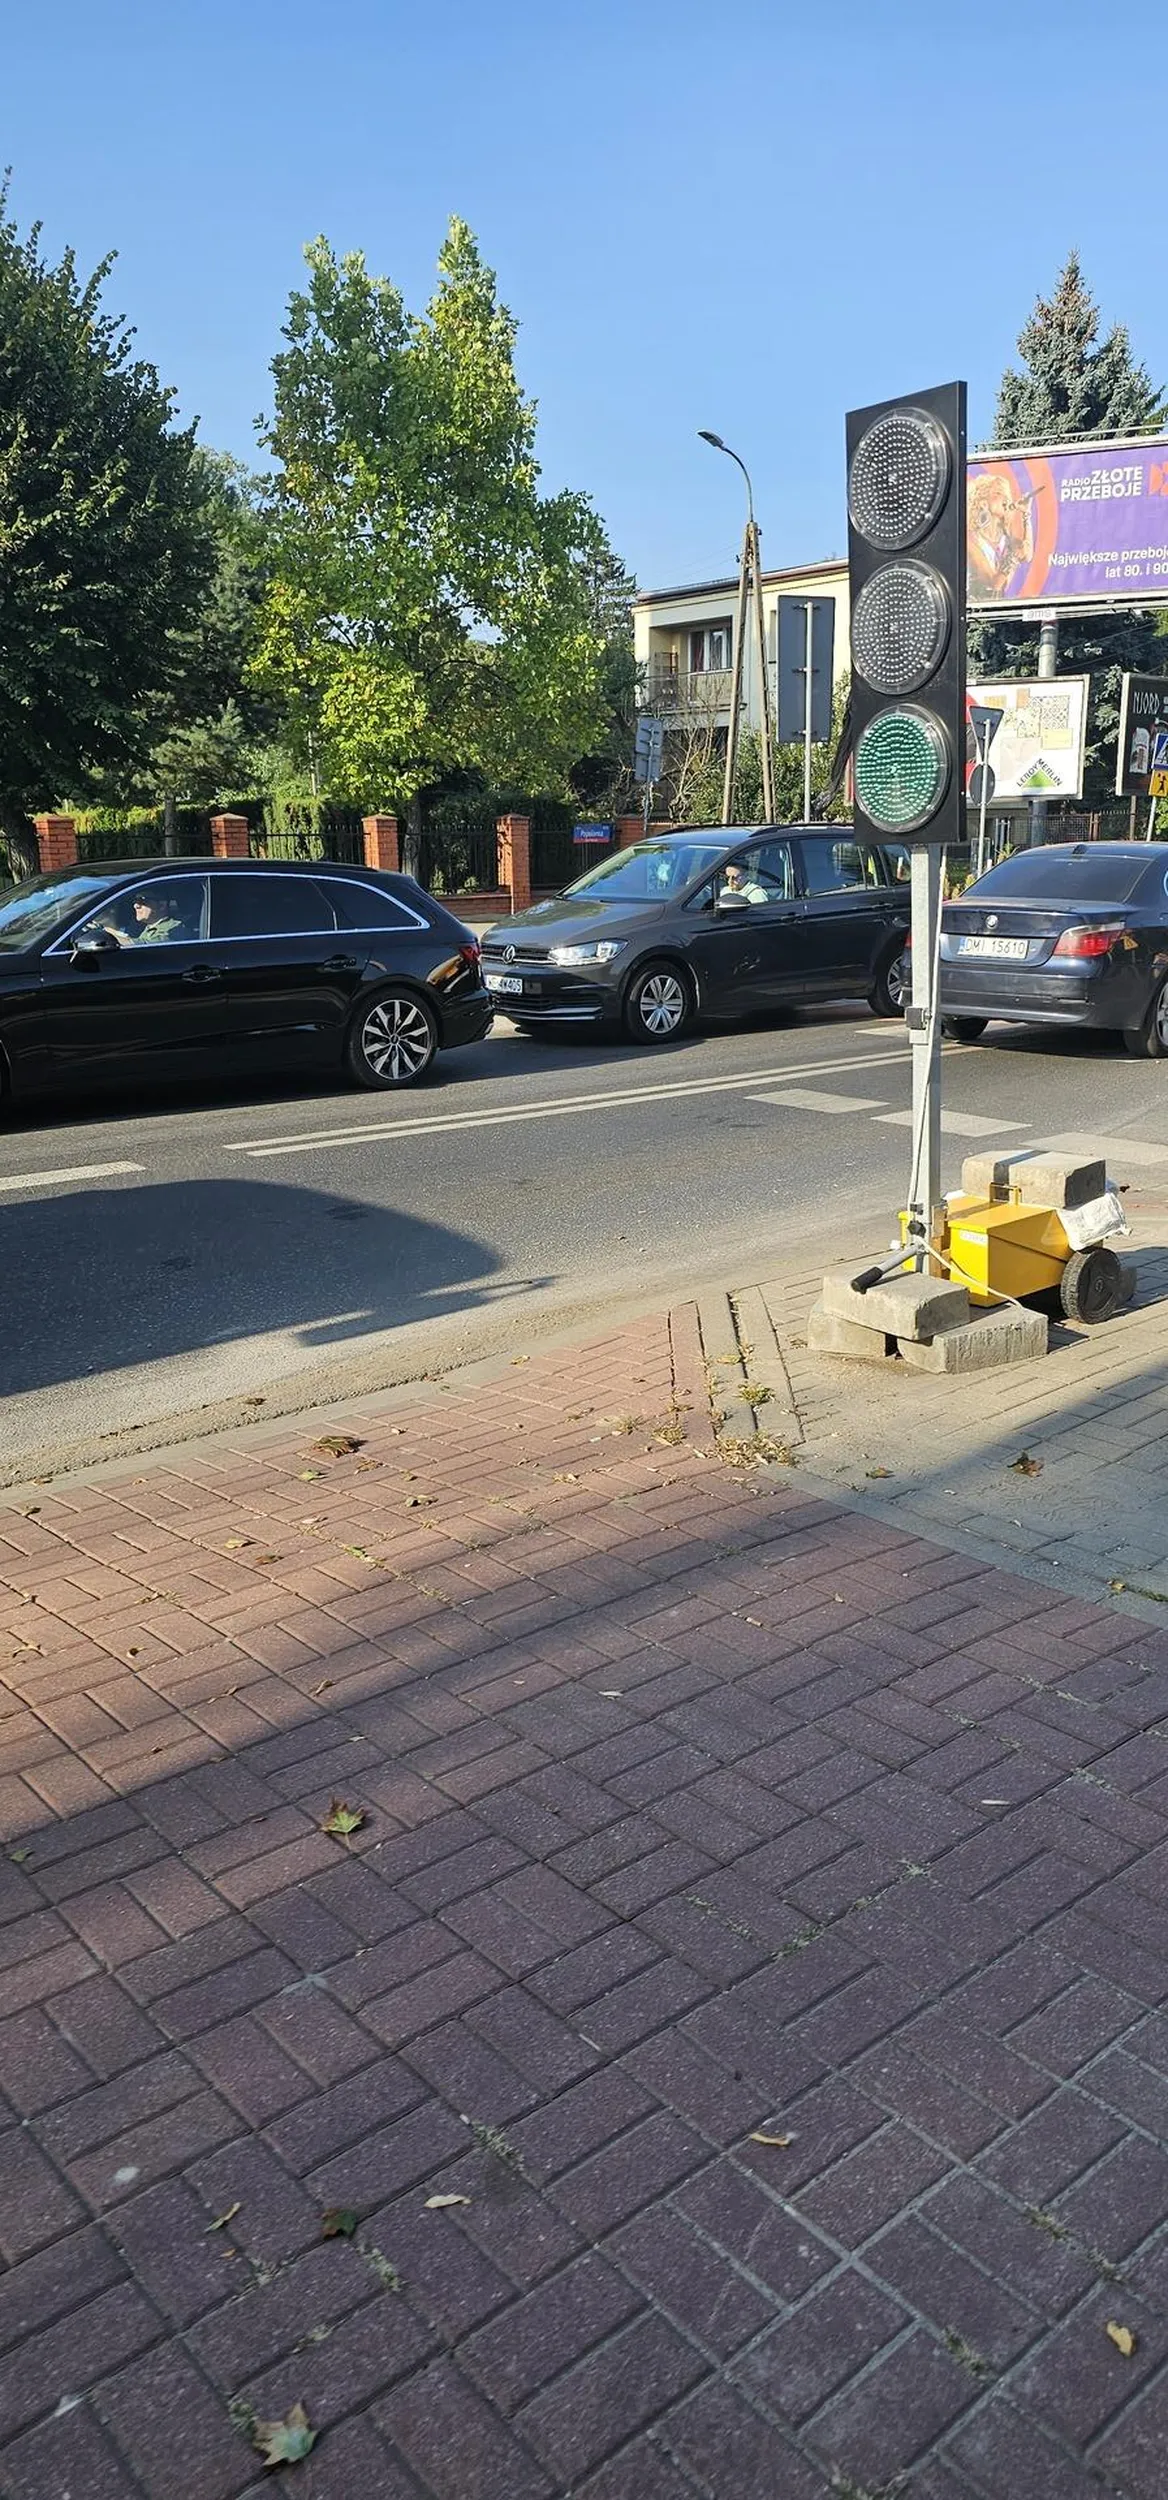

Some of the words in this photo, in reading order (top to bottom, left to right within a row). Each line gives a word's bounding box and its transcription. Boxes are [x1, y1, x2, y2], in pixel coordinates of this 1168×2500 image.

[1061, 477, 1091, 488] RADIO
[1091, 466, 1143, 485] ZŁOTE
[1060, 482, 1142, 502] PRZEBOJE
[1048, 552, 1118, 567] Największe
[1105, 566, 1120, 578] lat
[1123, 564, 1143, 577] 80.
[1146, 563, 1150, 575] i
[1016, 763, 1039, 788] LEROY
[1037, 758, 1063, 787] MERLIN
[992, 940, 1026, 954] 15610
